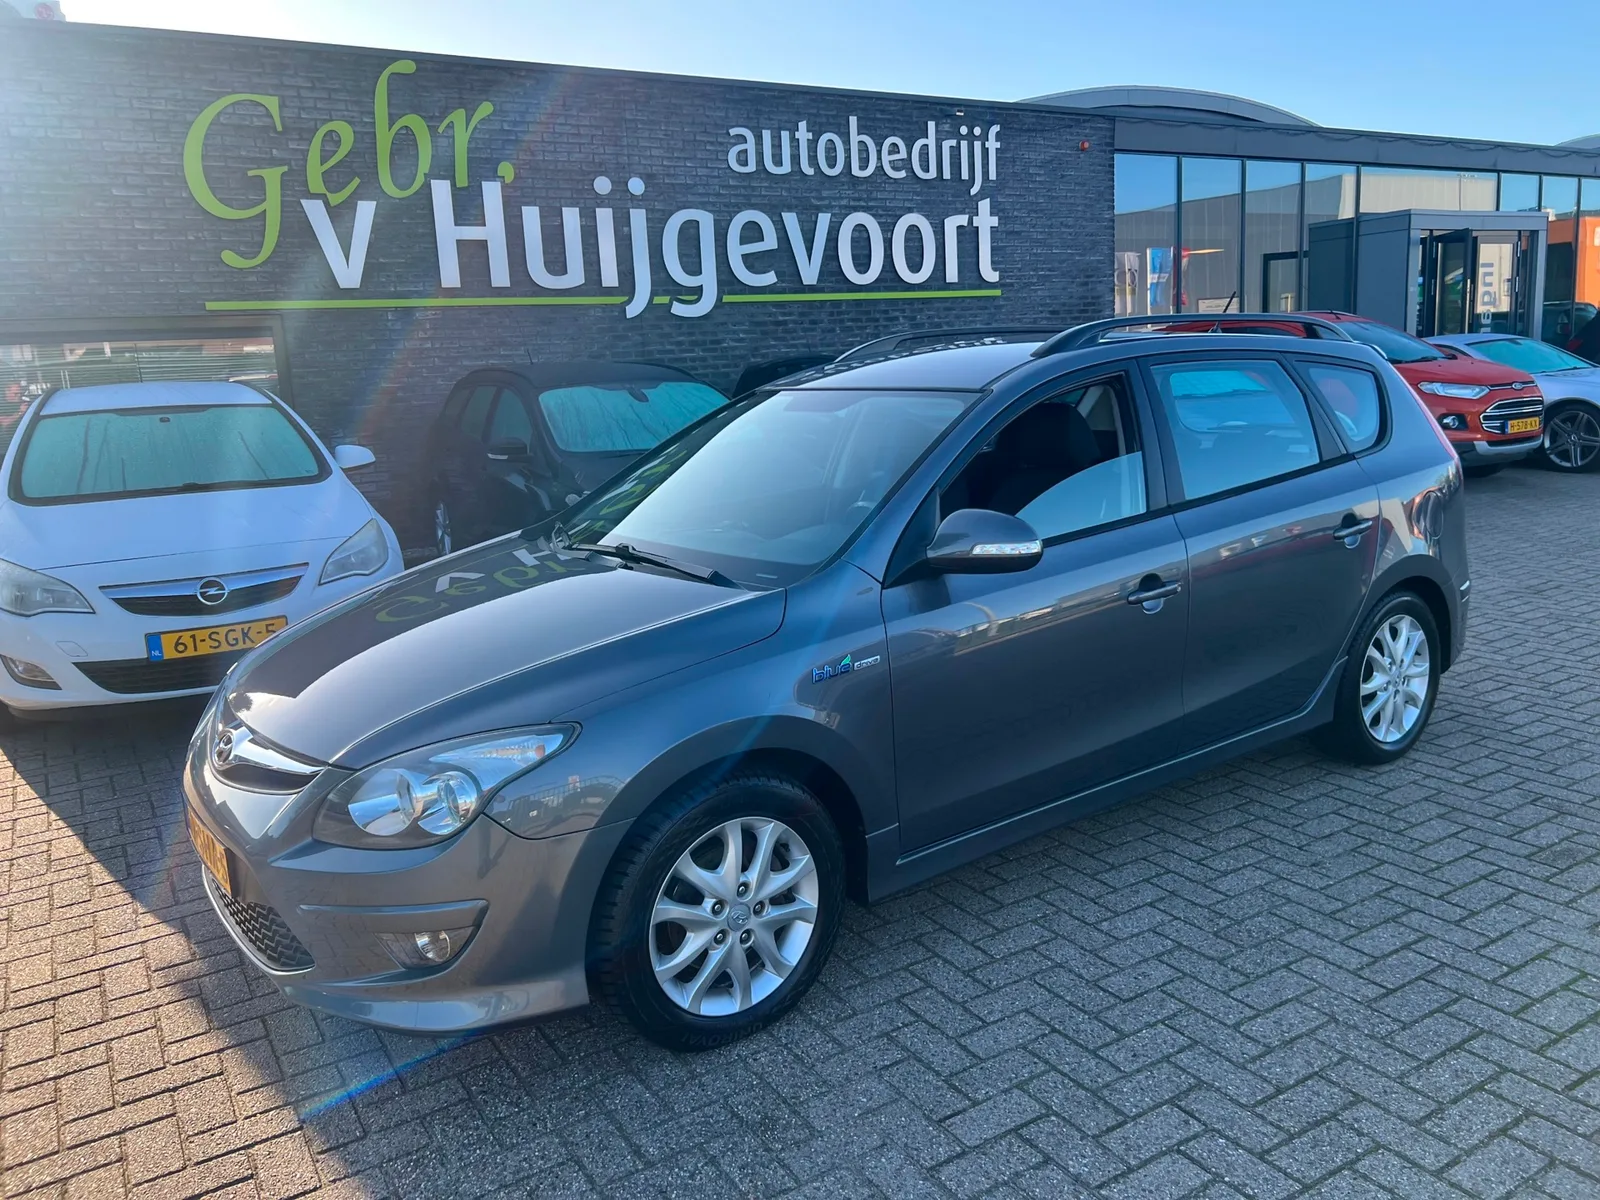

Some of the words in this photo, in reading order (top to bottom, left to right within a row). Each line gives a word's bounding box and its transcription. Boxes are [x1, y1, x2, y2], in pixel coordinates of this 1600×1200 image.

[727, 115, 1001, 196] autobedrijf
[300, 198, 377, 289] v
[430, 178, 1001, 319] Huijgevoort
[812, 660, 852, 684] blue
